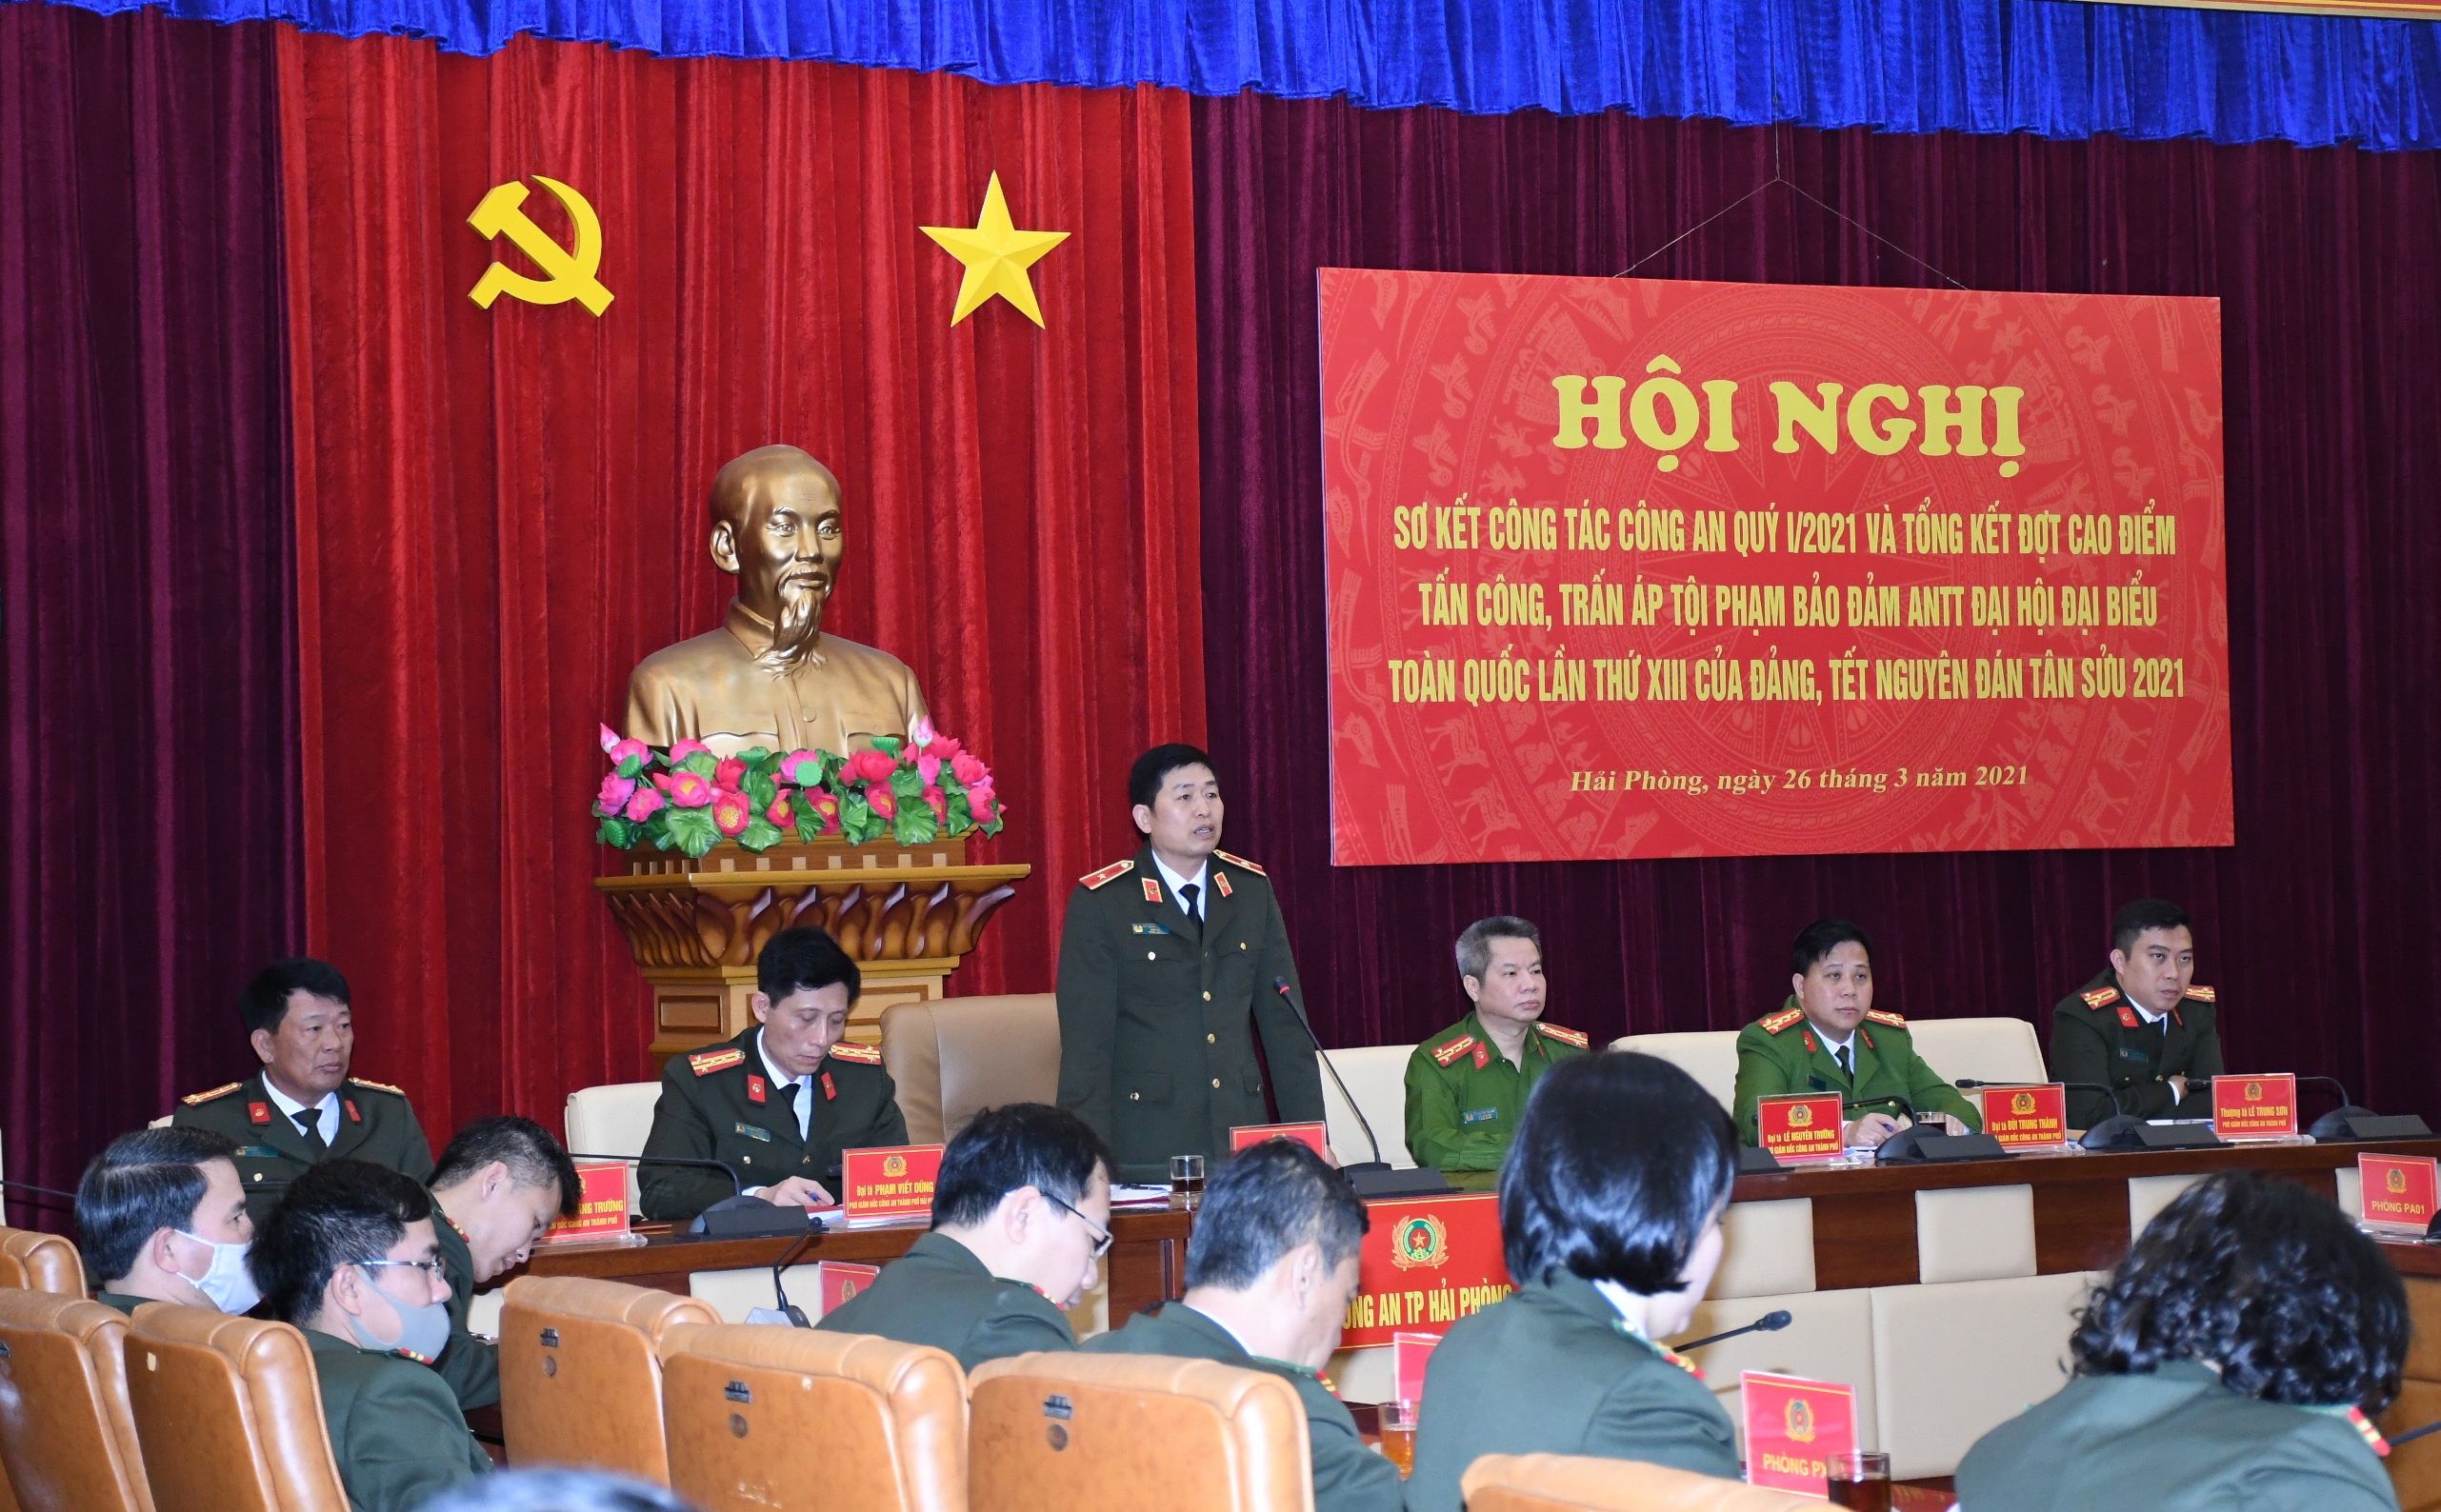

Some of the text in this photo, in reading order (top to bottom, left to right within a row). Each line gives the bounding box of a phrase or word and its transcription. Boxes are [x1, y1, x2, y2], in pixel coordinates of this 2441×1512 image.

[1552, 354, 2025, 477] HỘI NGHỊ
[1394, 493, 2175, 562] SƠ KẾT CÔNG TÁC CÔNG AN QUÝ I/2021 VÀ TỔNG KẾT ĐỢT CAO ĐIỂM
[1419, 567, 2156, 636] TẤN CÔNG, TRẤN ÁP TỘI PHẠM BẢO ĐẢM ANTT ĐẠI HỘI ĐẠI BIỂU
[1389, 644, 2183, 706] TOÀN QUỐC LẦN THỨ XIII CỦA ĐẢNG, TẾT NGUYÊN ĐÁN TÂN SỬU 2021
[1571, 766, 2027, 795] Hải Phòng, ngày 26 tháng 3 năm 2021
[2038, 1117, 2057, 1128] THÀNH
[2248, 1105, 2255, 1116] LÊ
[2256, 1106, 2274, 1116] TRUNG
[1784, 1130, 1791, 1142] LÊ
[1796, 1144, 1808, 1152] CÔNG
[1815, 1143, 1829, 1151] THÀNH
[875, 1184, 895, 1197] PHẠM
[897, 1180, 912, 1194] VIẾT
[2371, 1199, 2425, 1214] PHÒNG PA01
[1379, 1293, 1401, 1326] AN
[1405, 1291, 1424, 1323] TP
[1429, 1278, 1455, 1322] HẢI
[1764, 1451, 1809, 1476] PHÒNG
